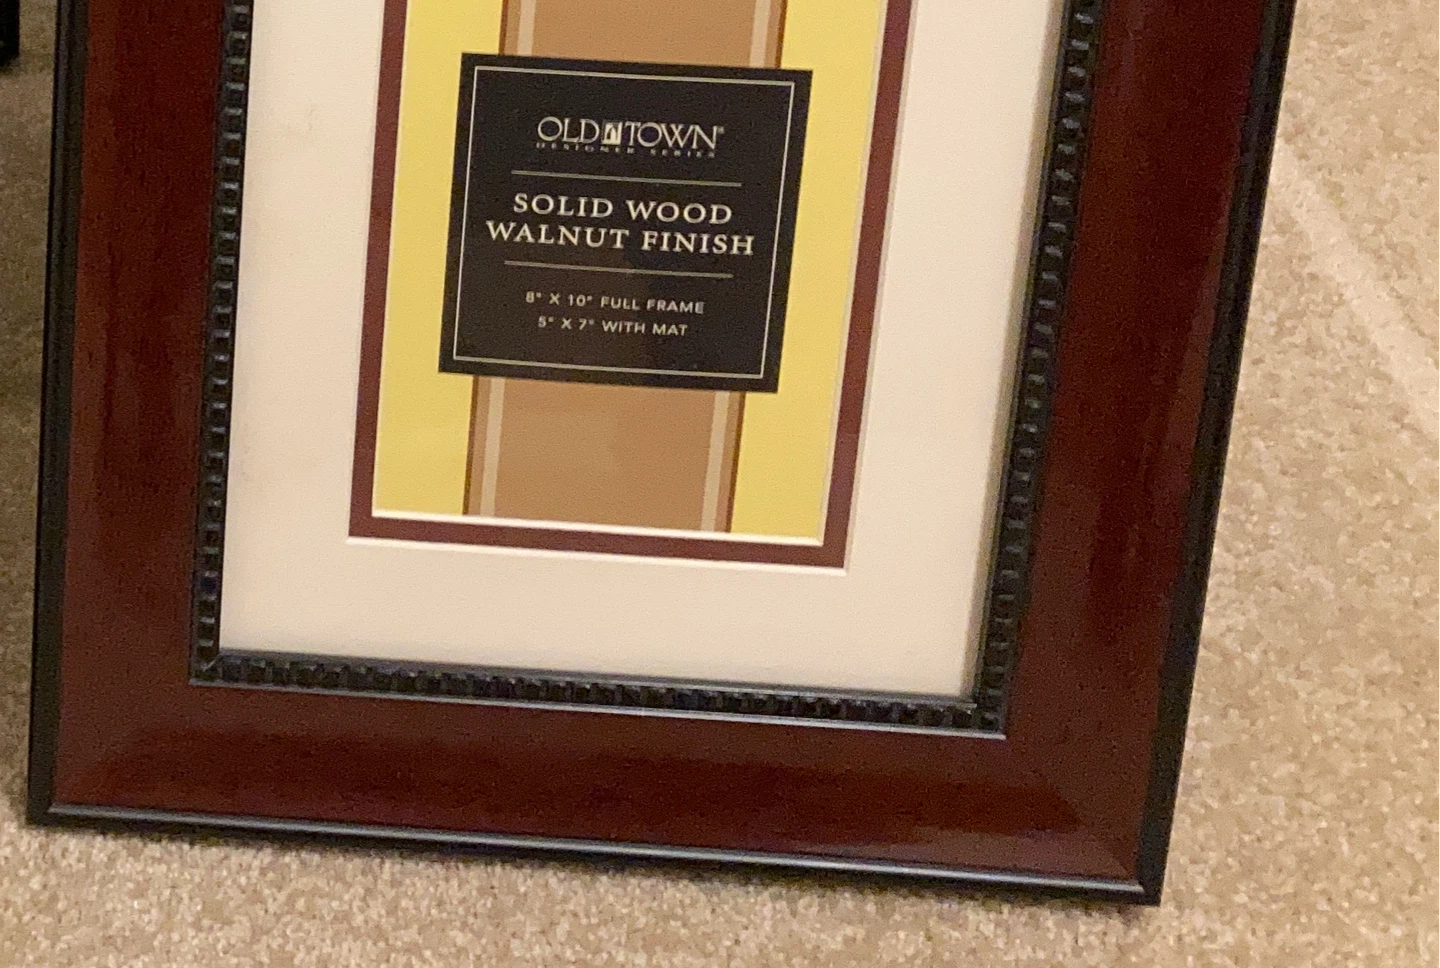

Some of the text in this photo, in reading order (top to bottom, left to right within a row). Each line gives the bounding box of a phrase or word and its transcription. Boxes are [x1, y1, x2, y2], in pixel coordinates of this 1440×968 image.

[537, 116, 600, 143] OLD
[512, 192, 733, 225] SOLID WOOD
[485, 219, 755, 257] WALNUT FINISH
[525, 290, 705, 315] 8" X 10" FULL FRAME
[537, 315, 688, 337] 5" X 7" WITH MAT
